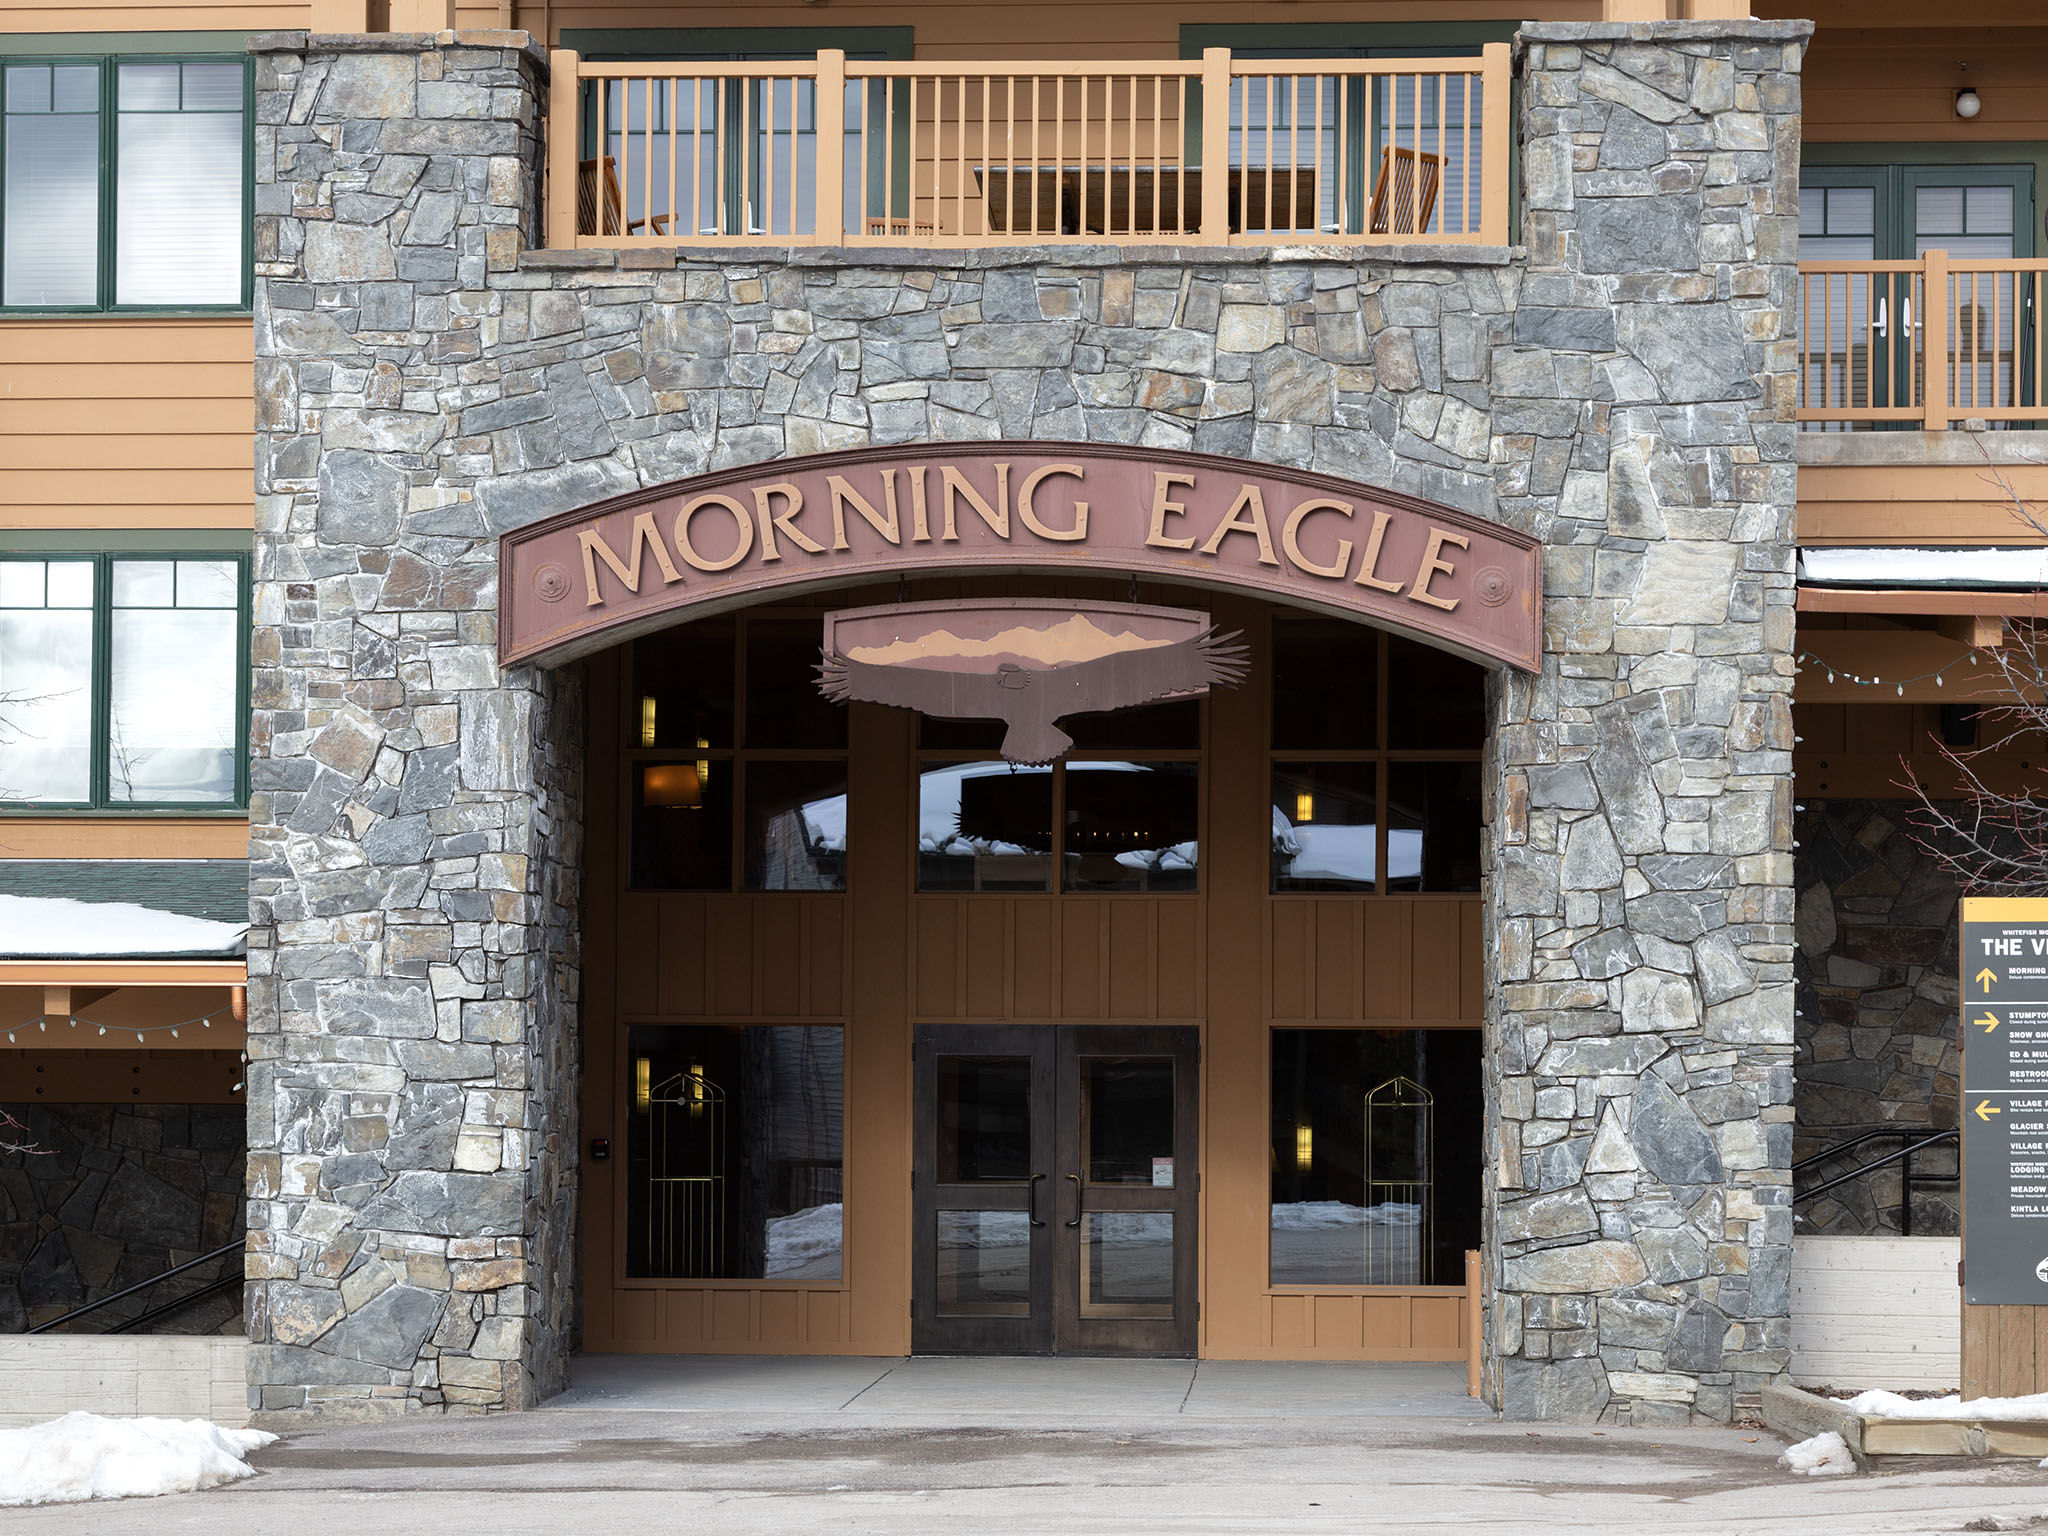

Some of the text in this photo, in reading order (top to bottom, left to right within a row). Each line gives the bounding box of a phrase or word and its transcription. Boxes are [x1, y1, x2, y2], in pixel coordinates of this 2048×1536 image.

[577, 463, 1470, 611] MORNING EAGLE
[1981, 938, 2023, 956] THE
[2009, 1011, 2048, 1019] STUMPTO
[2023, 1050, 2029, 1058] &
[2010, 1142, 2043, 1150] VILLAGE
[2011, 1205, 2039, 1213] KINTLA
